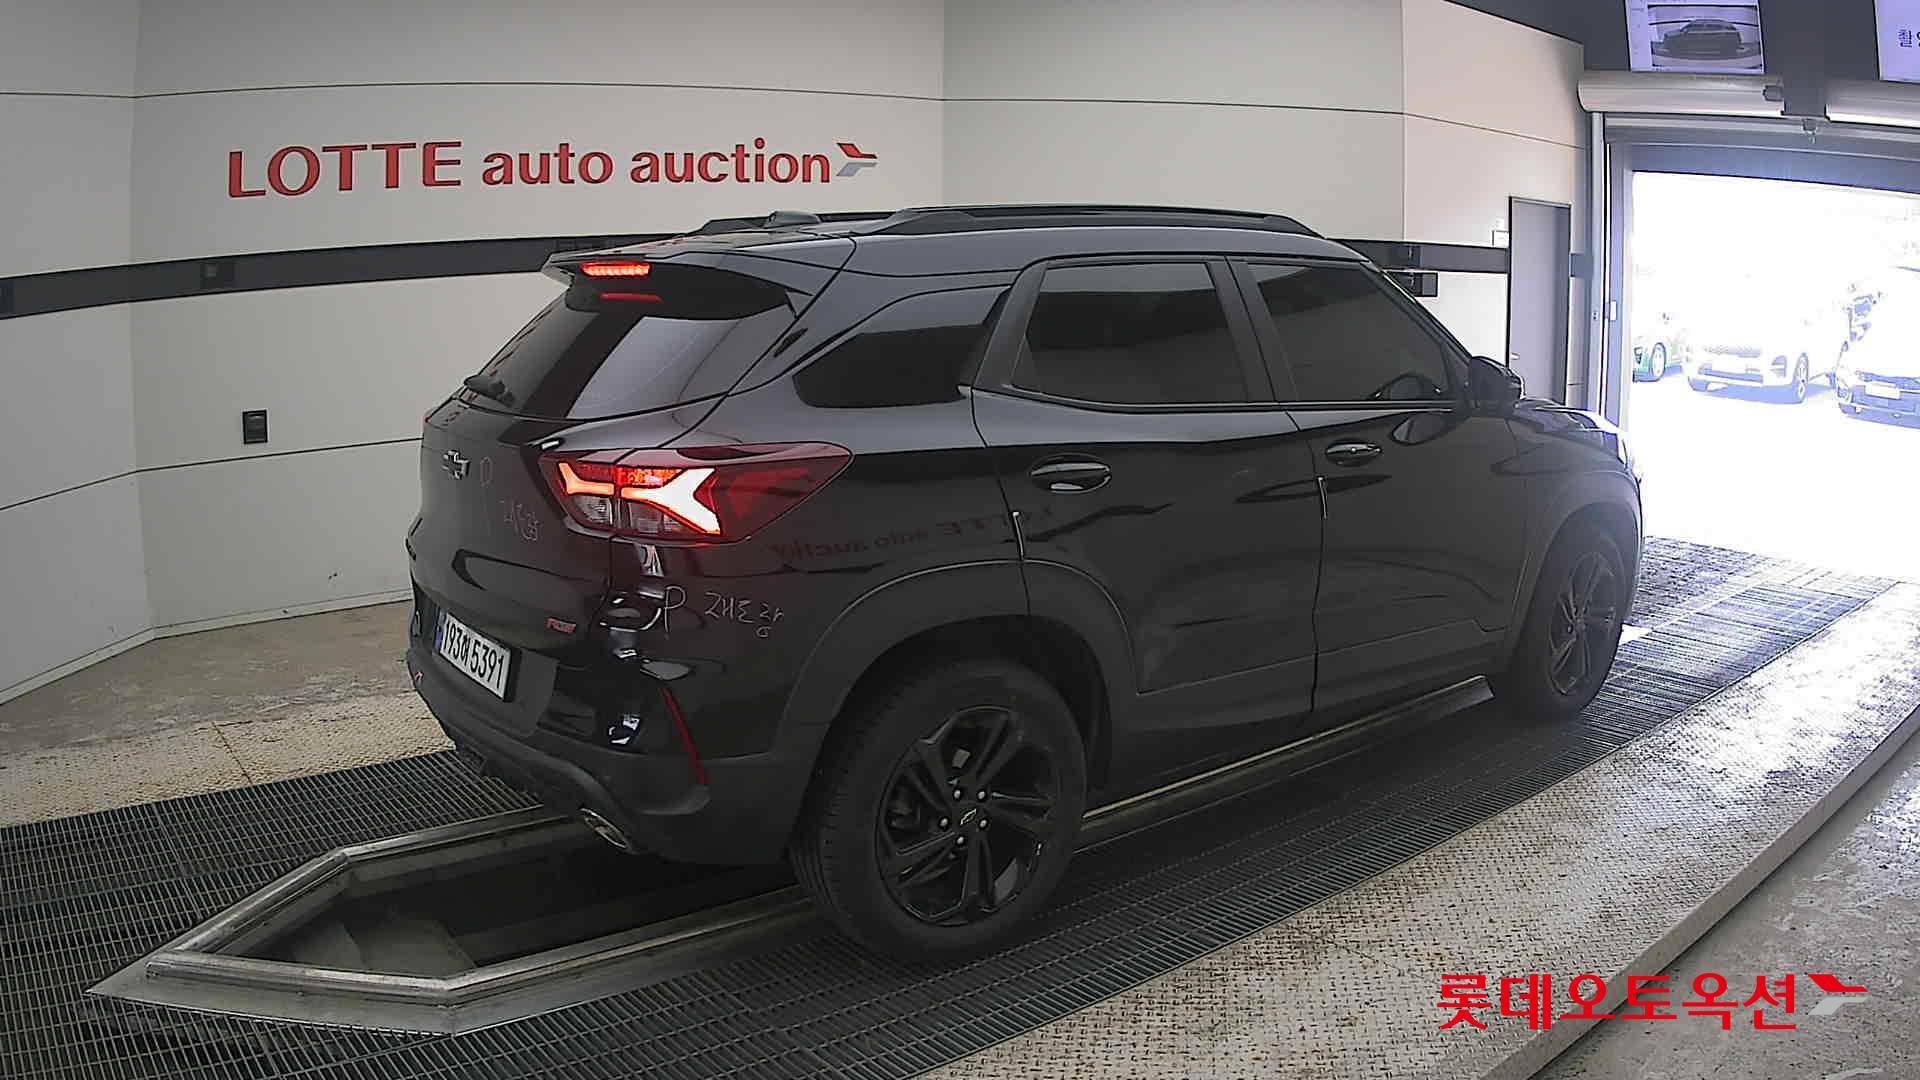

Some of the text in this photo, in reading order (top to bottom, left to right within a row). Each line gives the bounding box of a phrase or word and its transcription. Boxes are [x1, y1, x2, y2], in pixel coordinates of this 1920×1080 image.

[228, 138, 831, 198] LOTTE auto auction
